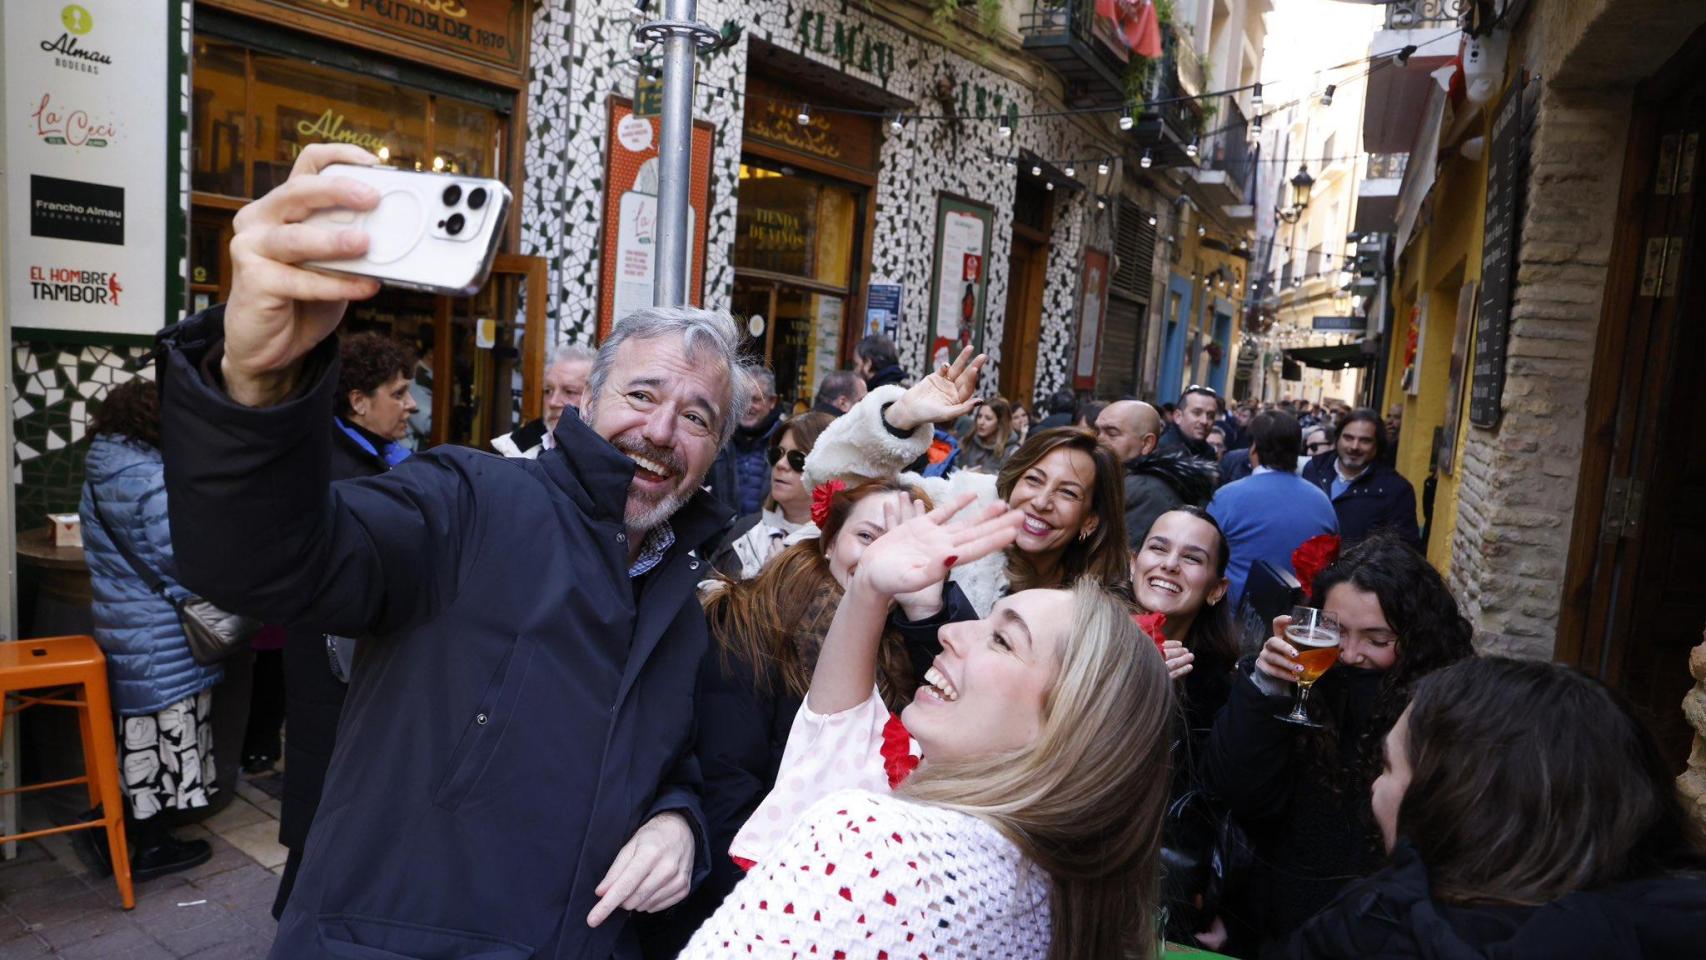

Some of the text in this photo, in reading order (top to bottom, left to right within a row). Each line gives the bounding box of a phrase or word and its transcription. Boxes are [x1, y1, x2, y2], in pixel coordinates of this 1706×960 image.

[39, 32, 112, 65] Almau
[55, 58, 99, 75] BODEGAS
[32, 93, 115, 146] La Ceci
[297, 108, 386, 149] Almau
[35, 200, 122, 219] Francho Almau
[30, 266, 108, 286] EL HOMBRE
[30, 281, 107, 304] TAMBOR
